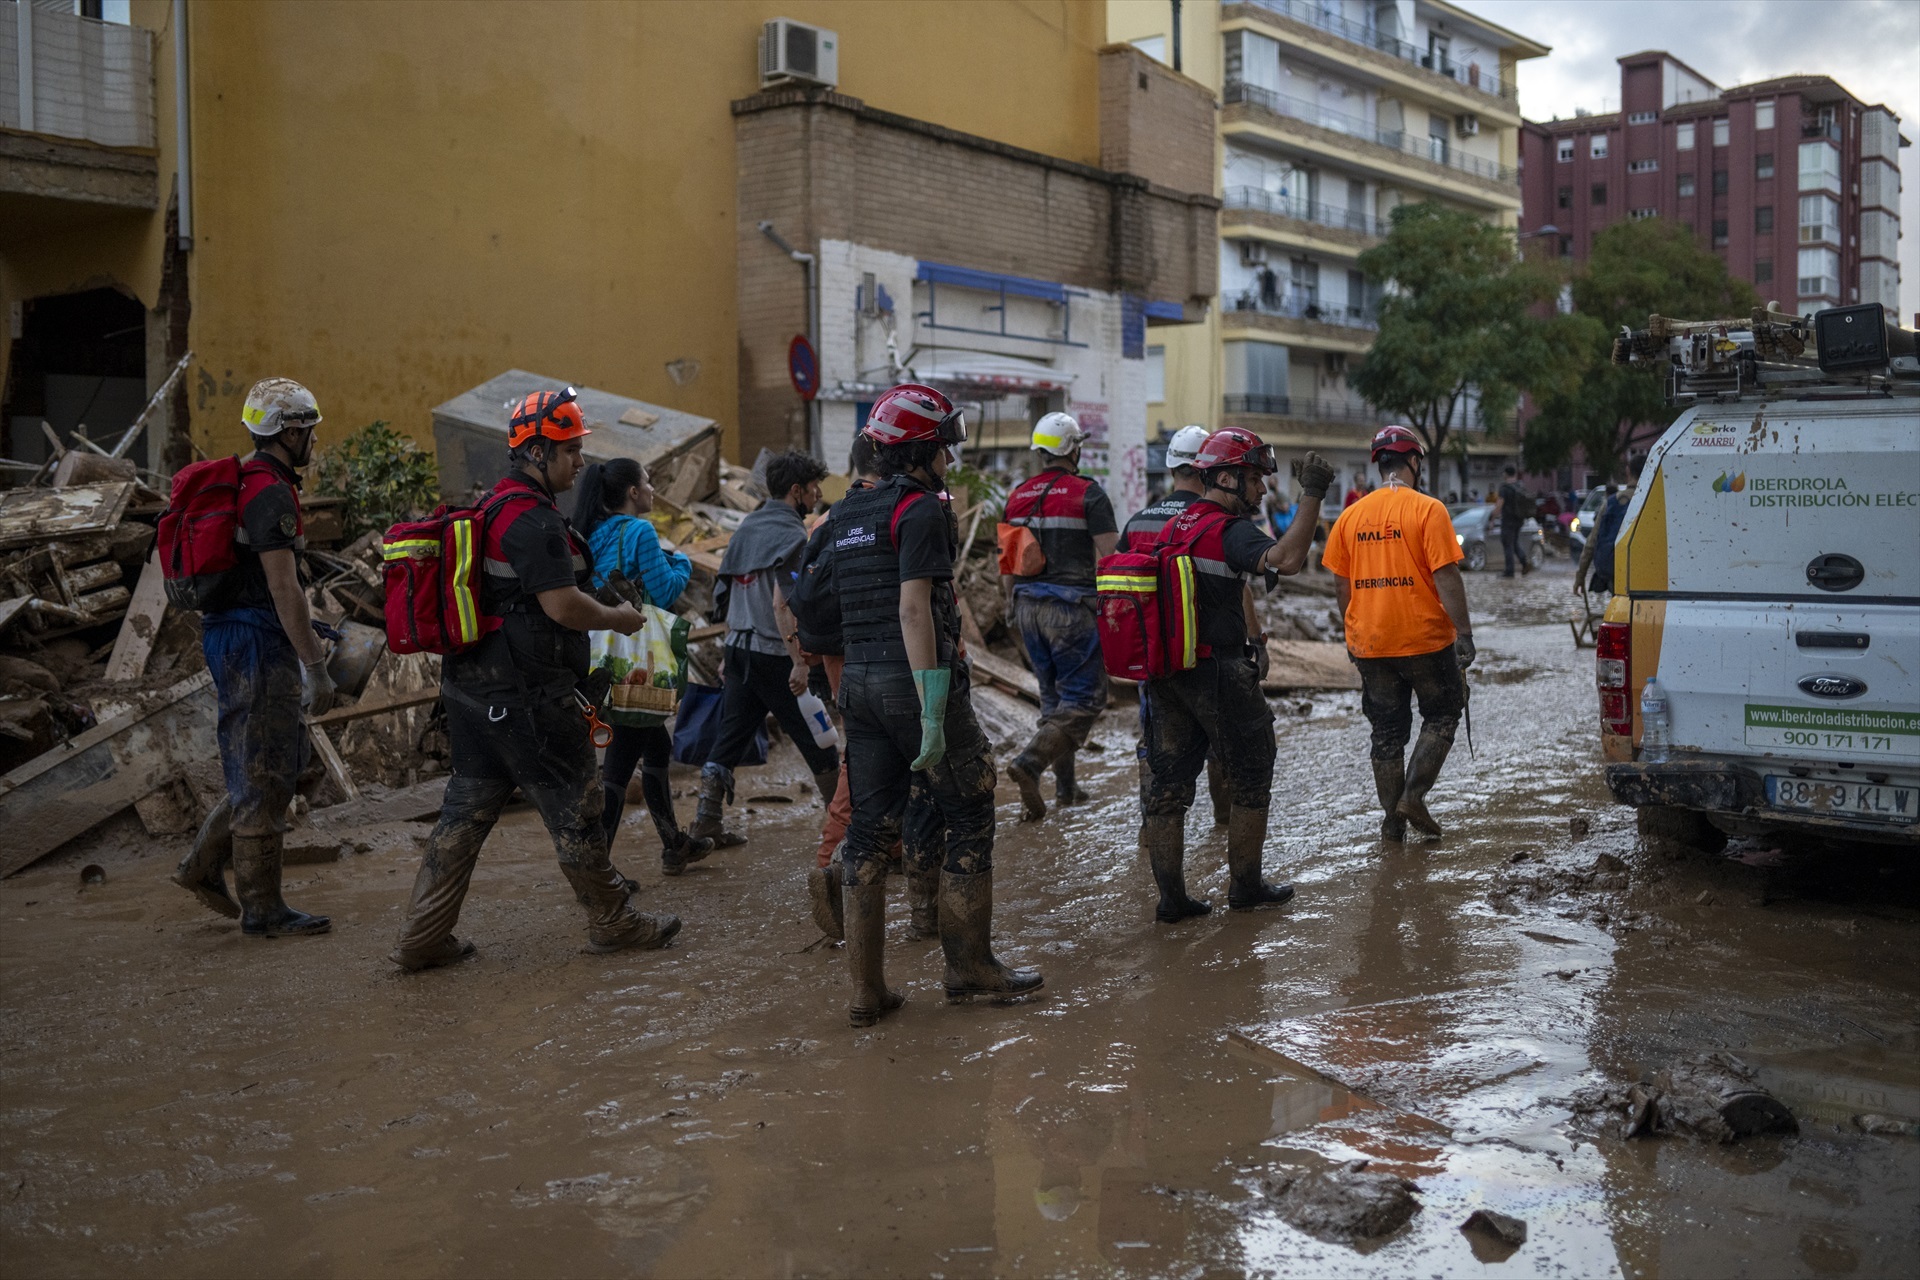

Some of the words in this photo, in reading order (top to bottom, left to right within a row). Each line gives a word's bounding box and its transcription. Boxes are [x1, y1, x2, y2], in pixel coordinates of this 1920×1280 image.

[1750, 478, 1847, 491] IBERDROLA
[1750, 491, 1870, 507] DISTRIBUCIÓN
[847, 526, 864, 537] URBE
[836, 533, 876, 548] EMERGENCIAS
[1812, 677, 1850, 694] Ford
[1783, 731, 1819, 746] 900
[1824, 734, 1853, 748] 171
[1861, 736, 1891, 750] 171
[1779, 780, 1847, 807] 889
